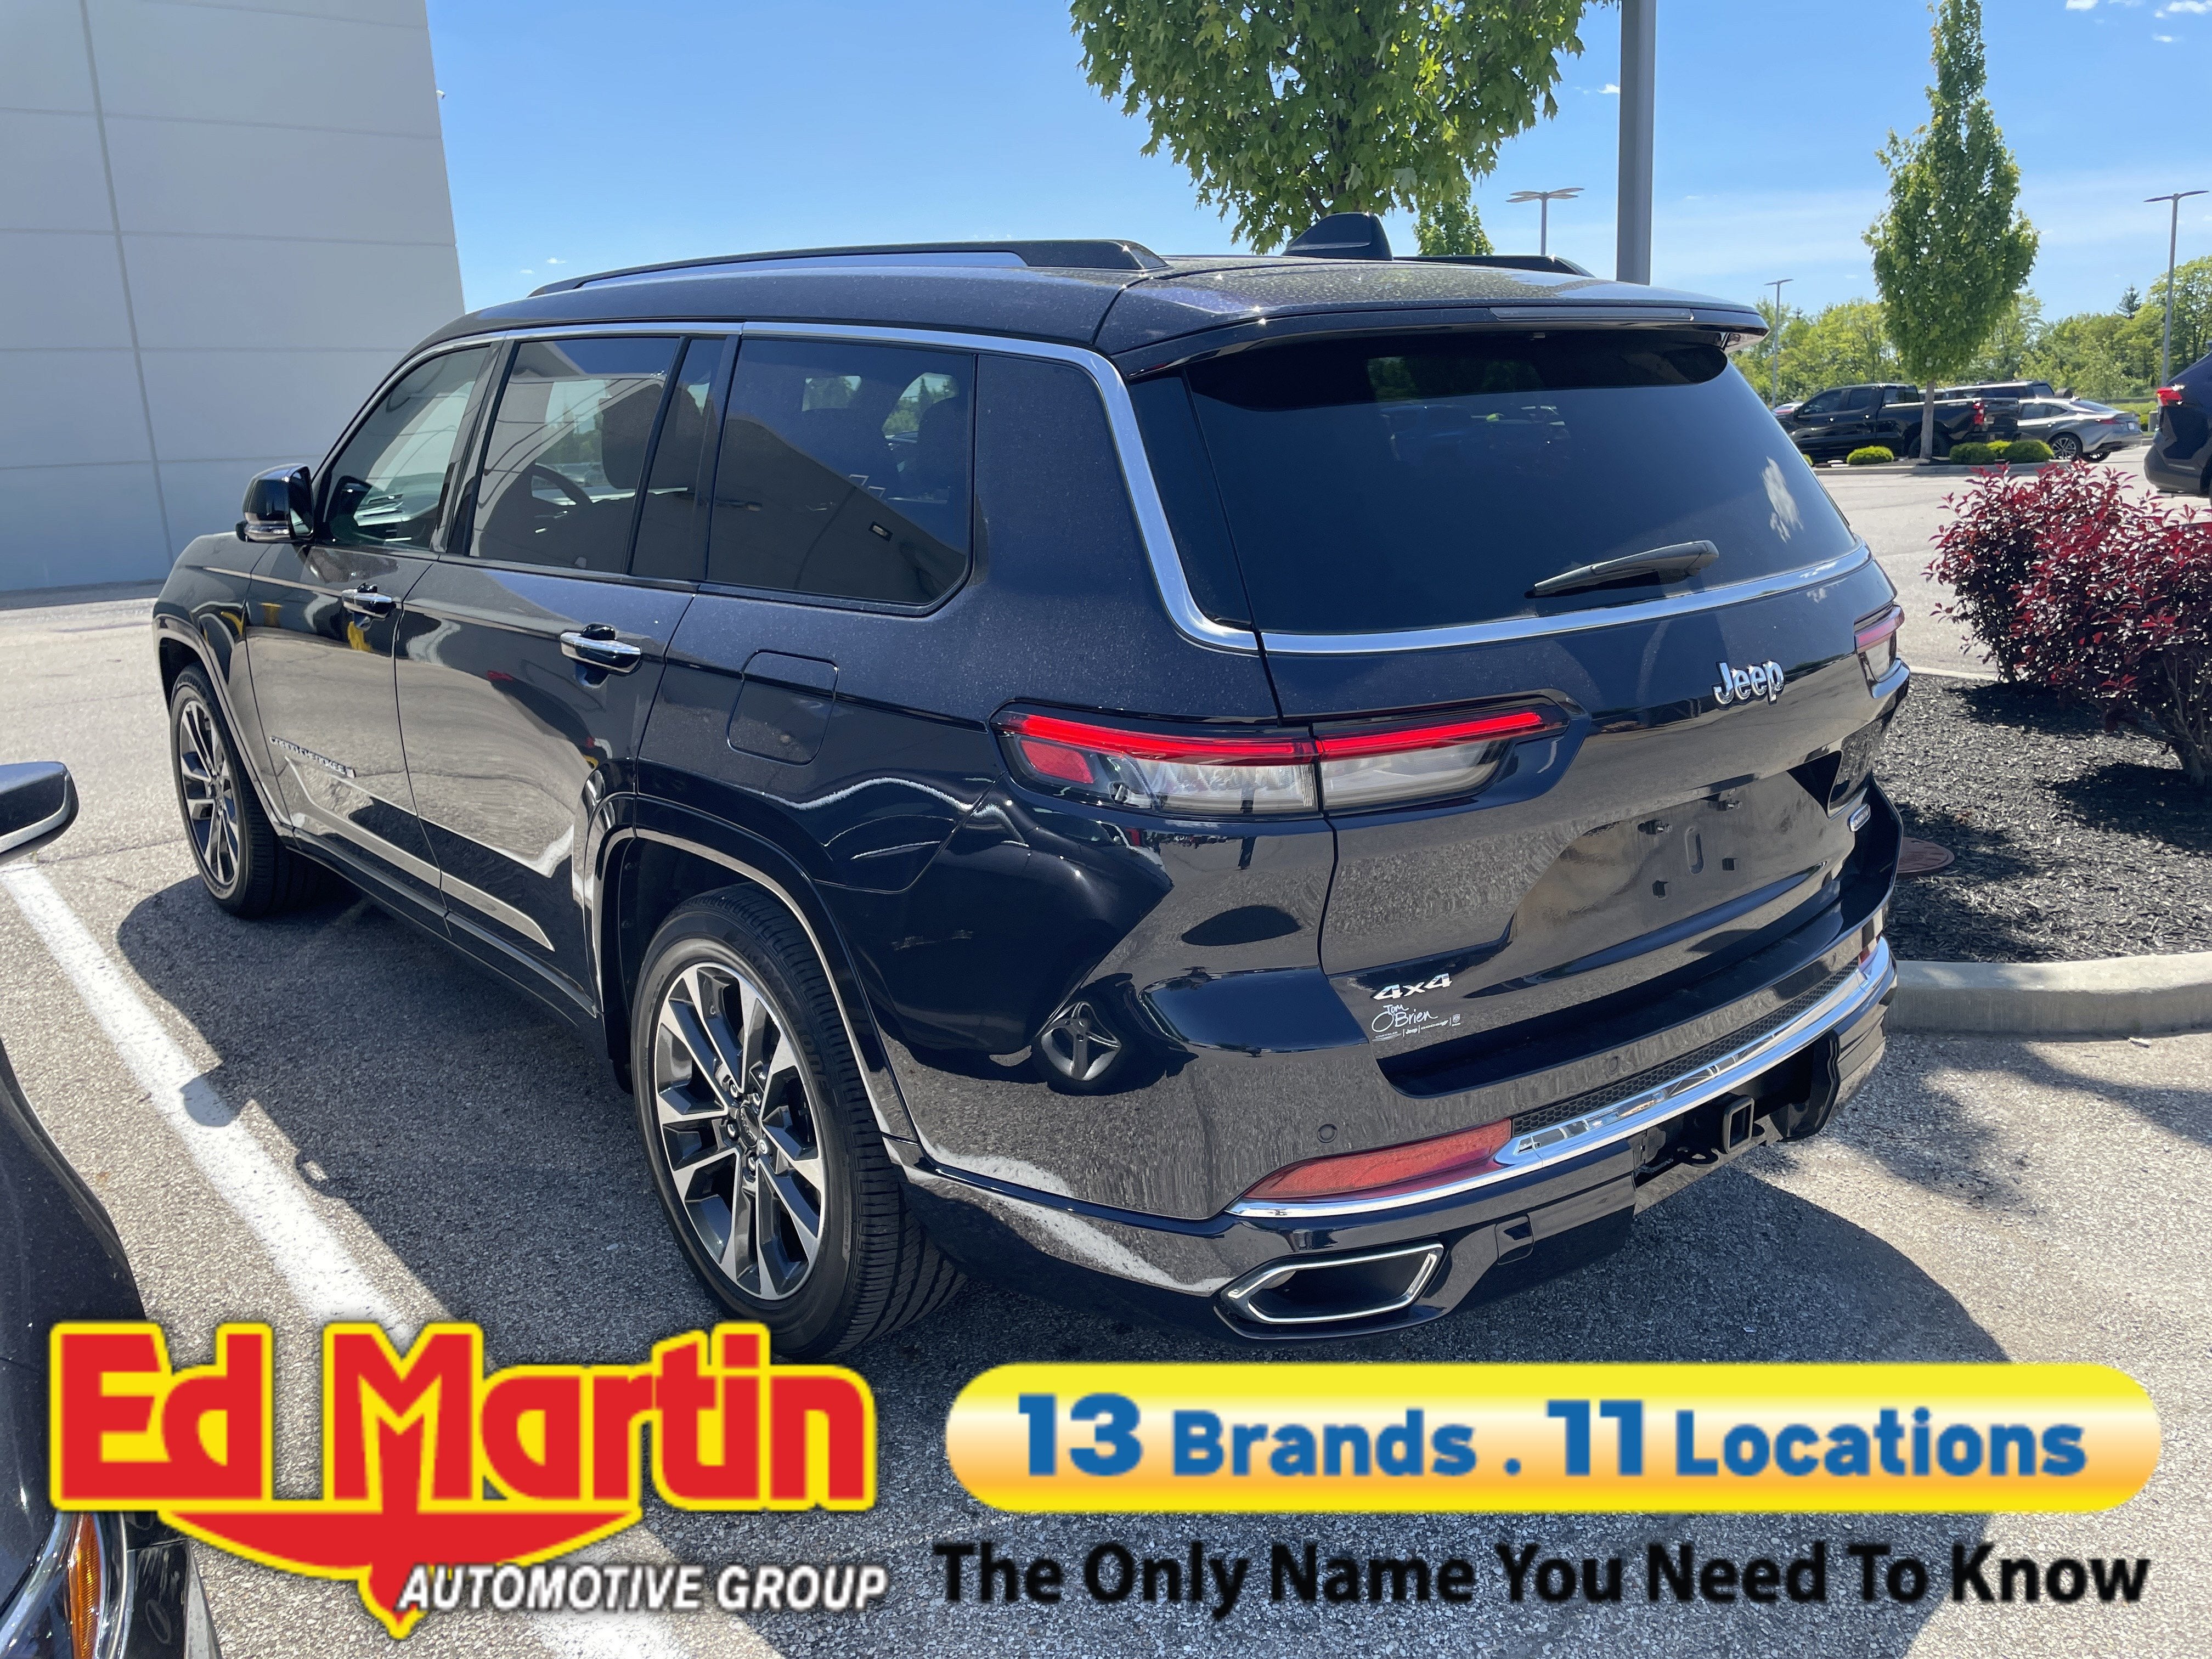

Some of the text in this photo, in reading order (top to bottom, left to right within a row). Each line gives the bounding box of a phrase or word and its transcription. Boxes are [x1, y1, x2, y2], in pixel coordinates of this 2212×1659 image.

[1713, 661, 1785, 705] Jeep
[1373, 973, 1453, 1000] 4x4
[1383, 1004, 1409, 1015] Tom
